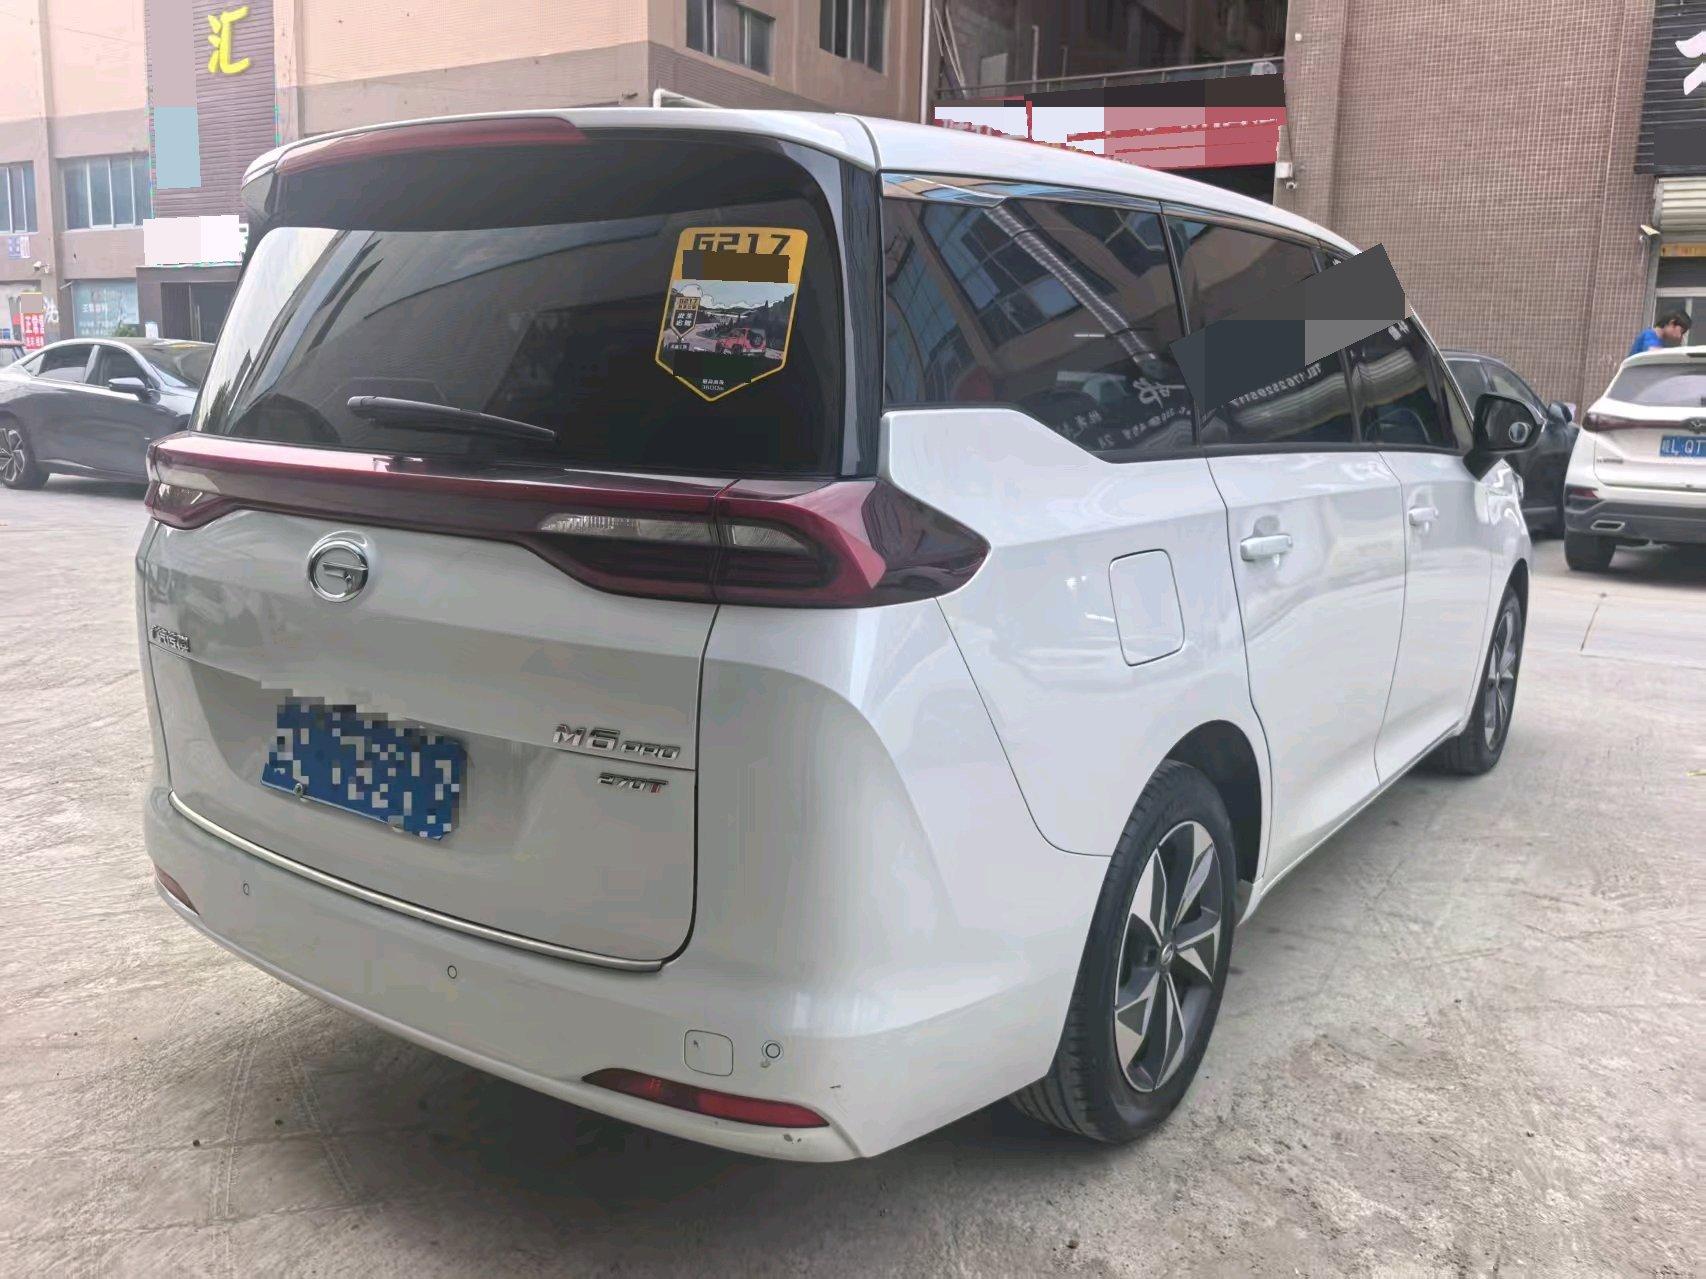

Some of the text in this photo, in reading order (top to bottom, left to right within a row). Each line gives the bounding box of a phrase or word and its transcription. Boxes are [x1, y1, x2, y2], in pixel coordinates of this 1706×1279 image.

[207, 6, 251, 73] 汇
[693, 233, 791, 254] G217
[553, 724, 681, 760] M6 PRO
[597, 772, 669, 793] 270T
